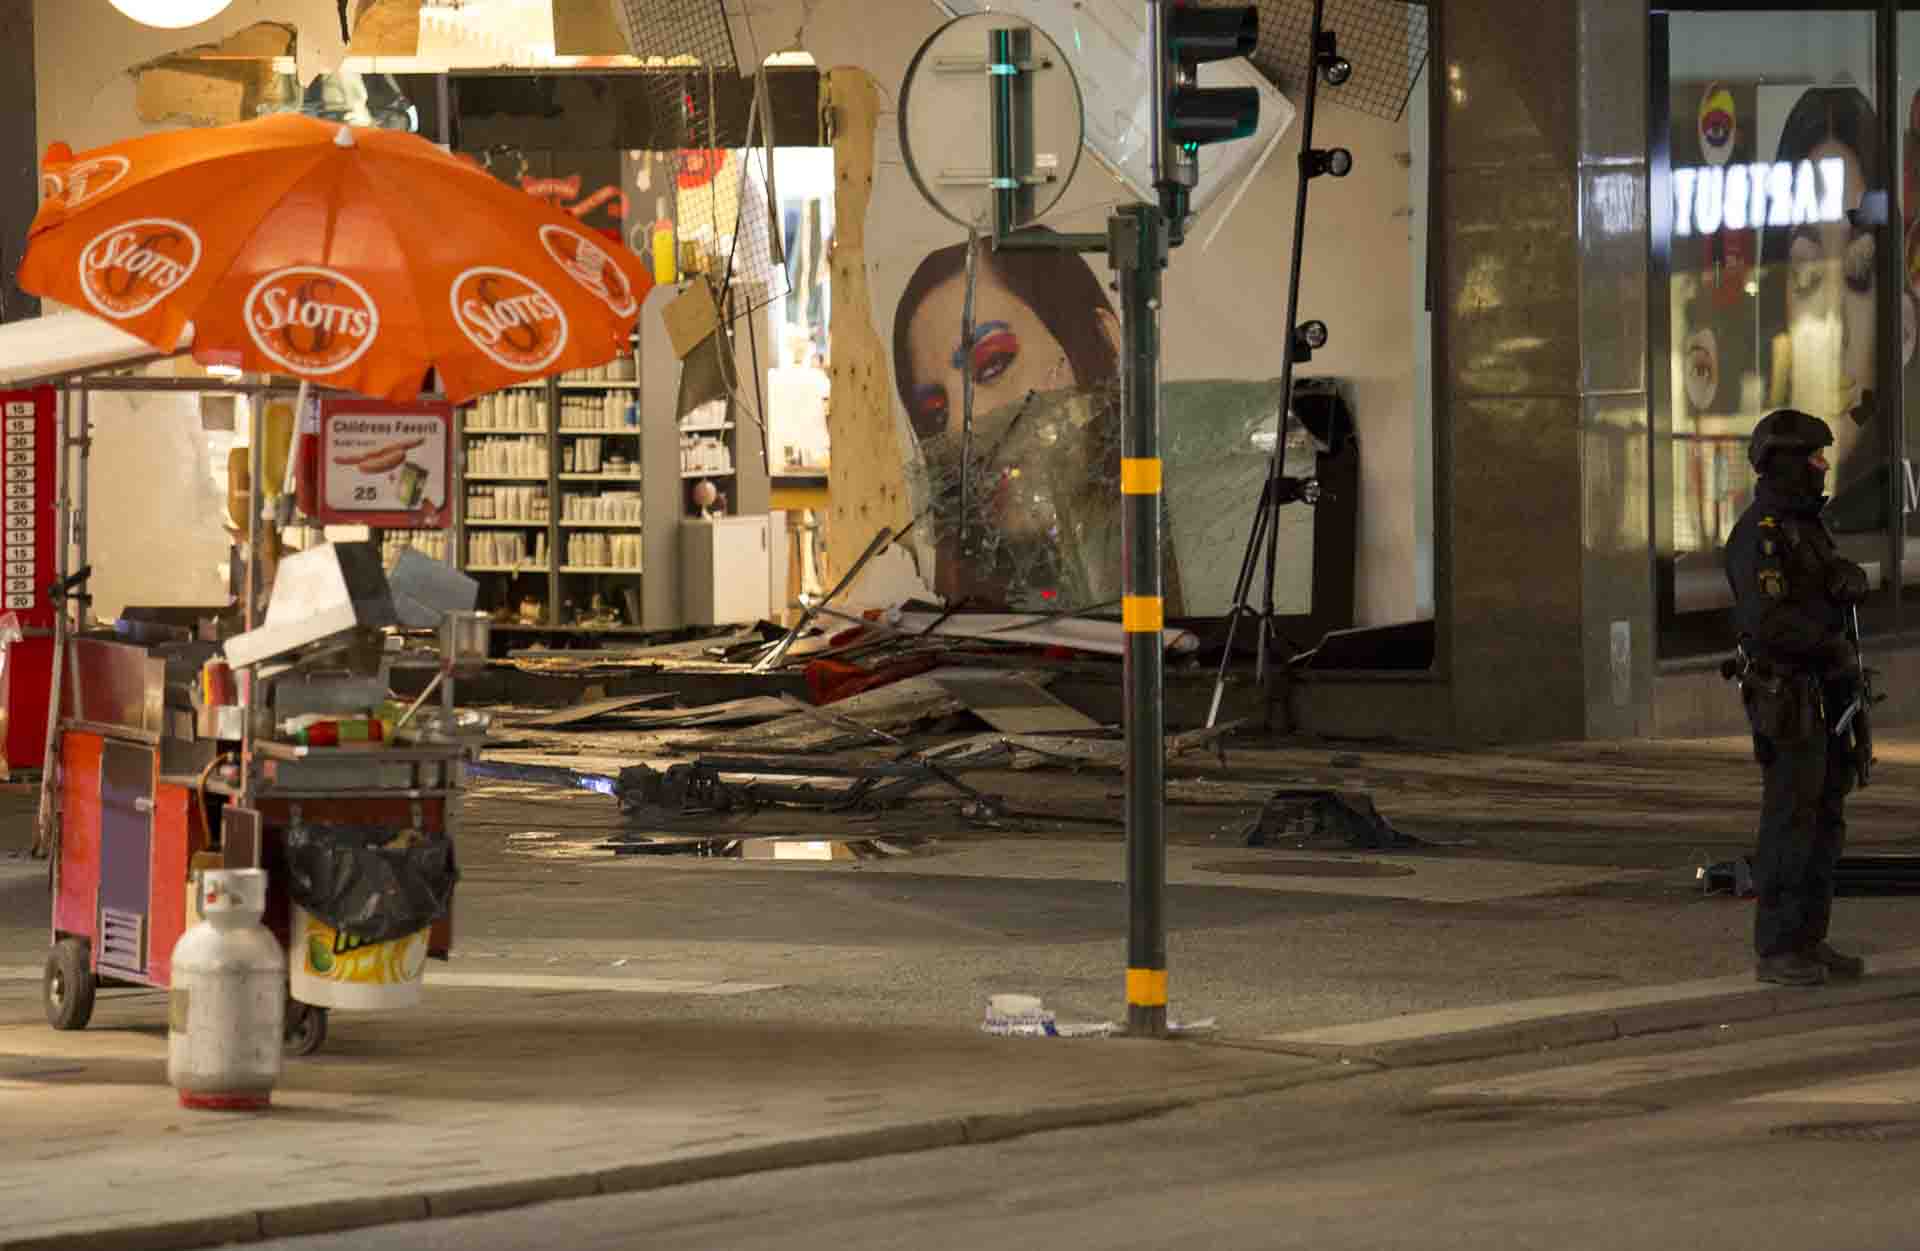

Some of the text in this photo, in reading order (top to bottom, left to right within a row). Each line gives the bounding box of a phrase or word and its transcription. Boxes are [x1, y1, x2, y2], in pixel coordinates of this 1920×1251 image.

[13, 404, 25, 415] 15
[13, 420, 25, 431] 15
[354, 486, 377, 501] 25
[13, 515, 28, 526] 30
[13, 531, 28, 542] 15
[13, 547, 28, 558] 15
[13, 563, 28, 574] 10
[13, 595, 28, 606] 20
